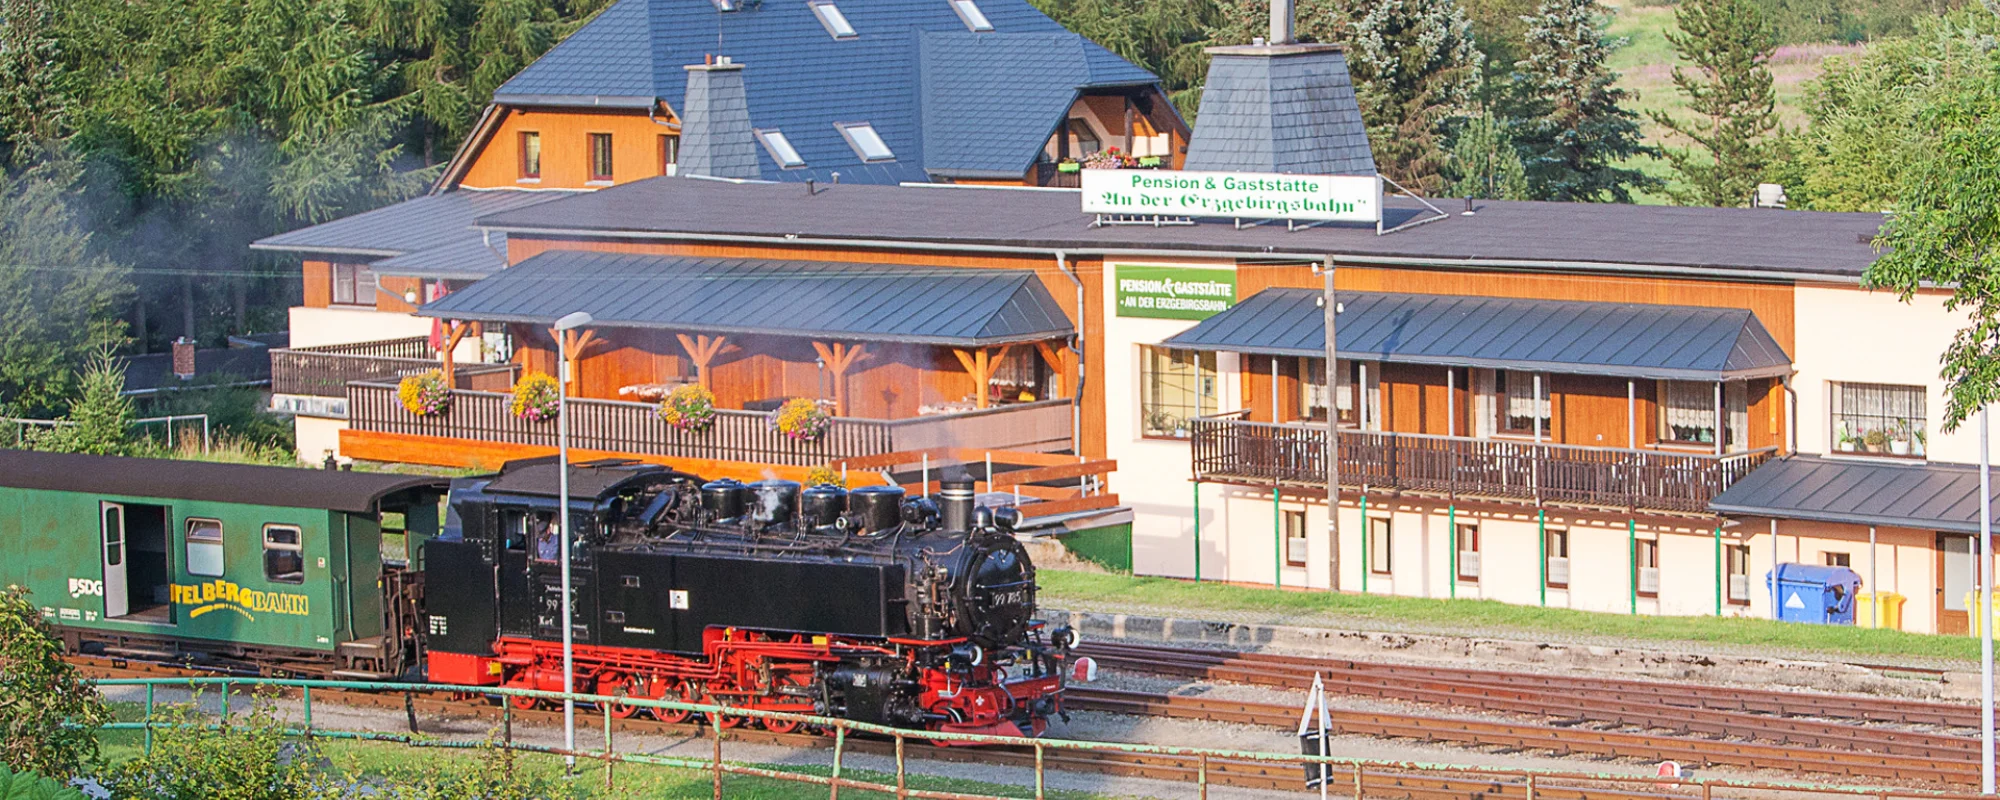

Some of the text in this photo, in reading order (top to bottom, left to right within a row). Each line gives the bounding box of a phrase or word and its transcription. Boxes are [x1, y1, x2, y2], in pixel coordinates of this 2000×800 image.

[1132, 174, 1319, 193] Pension & Gaststätte
[1141, 193, 1172, 206] der
[1120, 279, 1162, 293] PENSION
[1174, 280, 1232, 296] GASTSTÄTTE
[1138, 297, 1154, 308] DER
[1156, 297, 1226, 311] ERZGEBIRGSBAHN
[78, 578, 103, 596] SDG
